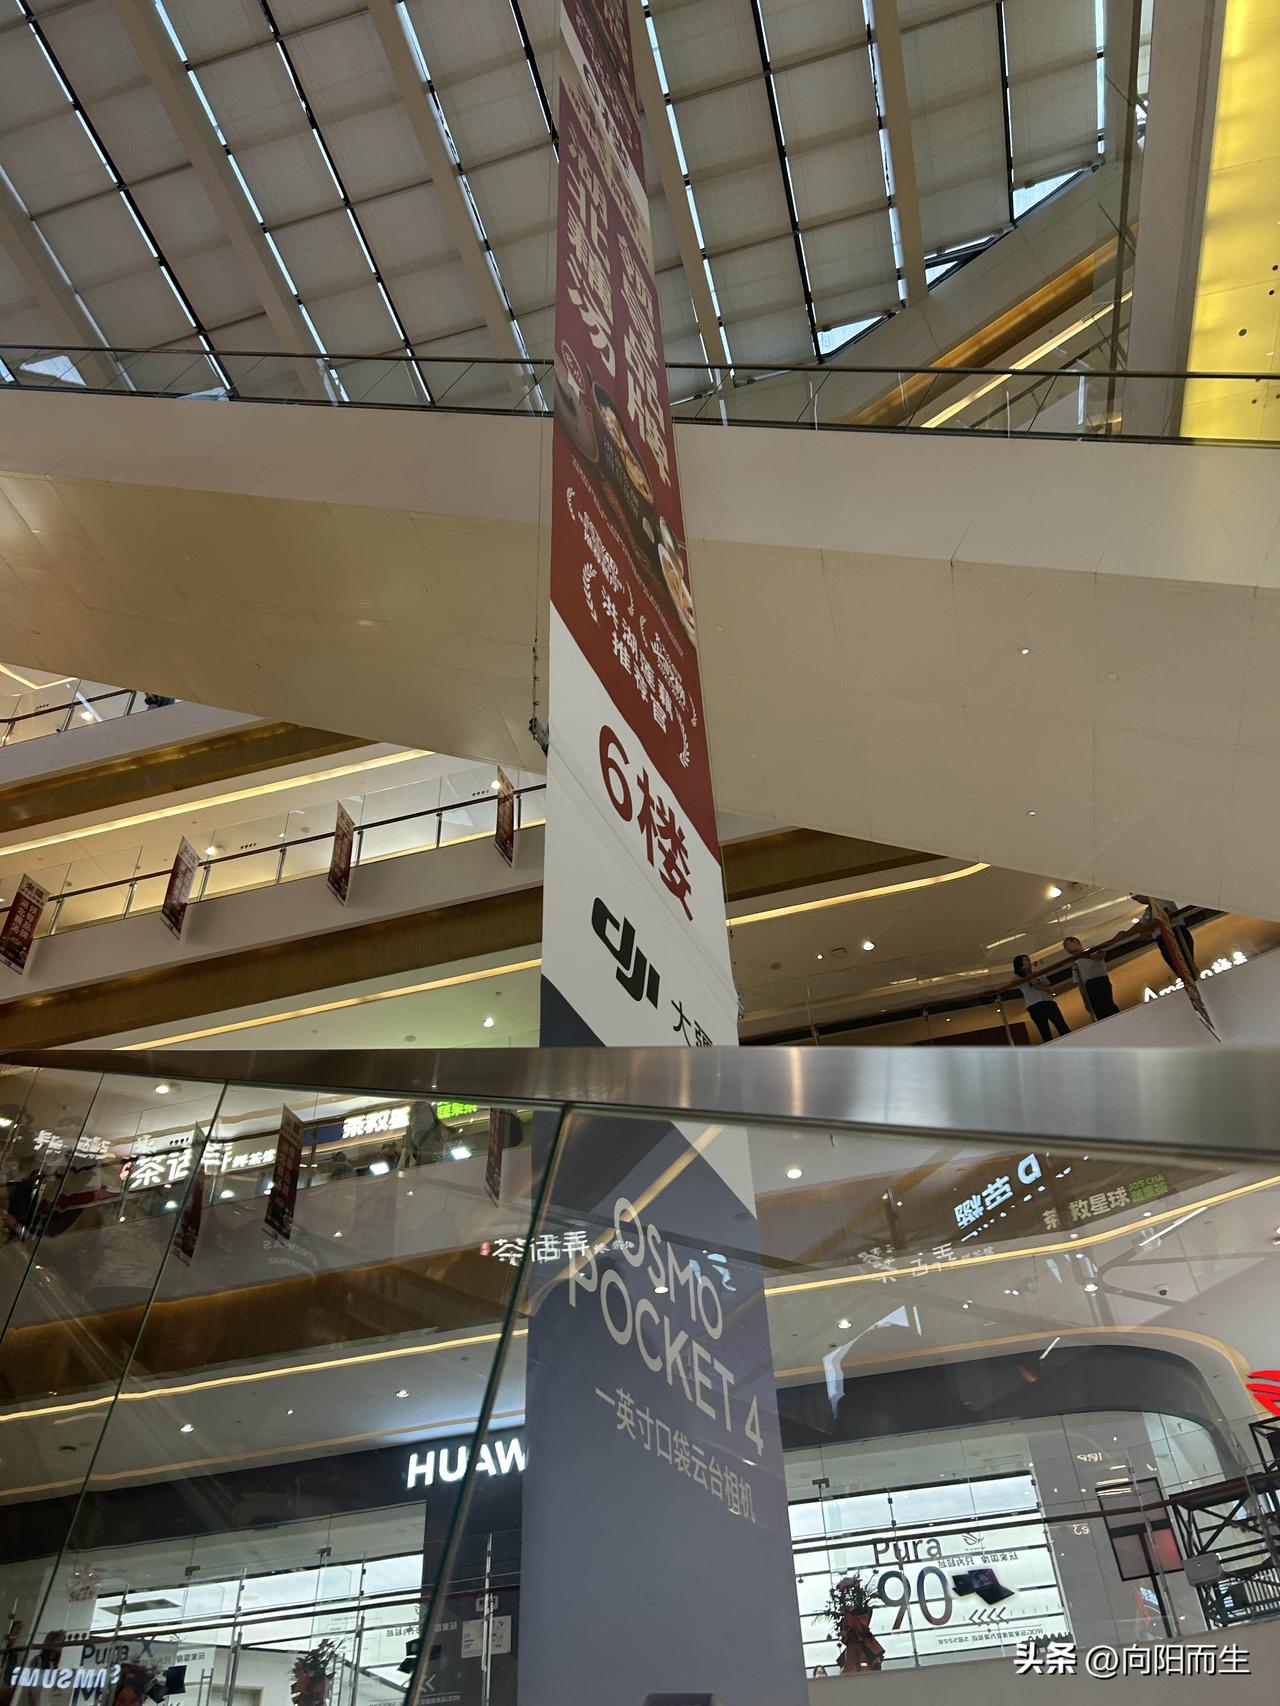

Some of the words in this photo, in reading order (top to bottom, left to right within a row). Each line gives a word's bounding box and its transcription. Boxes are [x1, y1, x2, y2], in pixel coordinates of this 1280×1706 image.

[567, 121, 616, 378] 湖北藕汤
[617, 232, 671, 488] 领导品牌
[599, 725, 693, 921] 6楼
[591, 897, 660, 1009] DJI
[613, 1197, 723, 1340] OSMO
[568, 1249, 735, 1432] POCKET
[744, 1394, 764, 1457] 4
[594, 1387, 756, 1523] 一英寸口袋云台相机
[872, 1537, 942, 1566] Pura
[878, 1566, 953, 1631] 90
